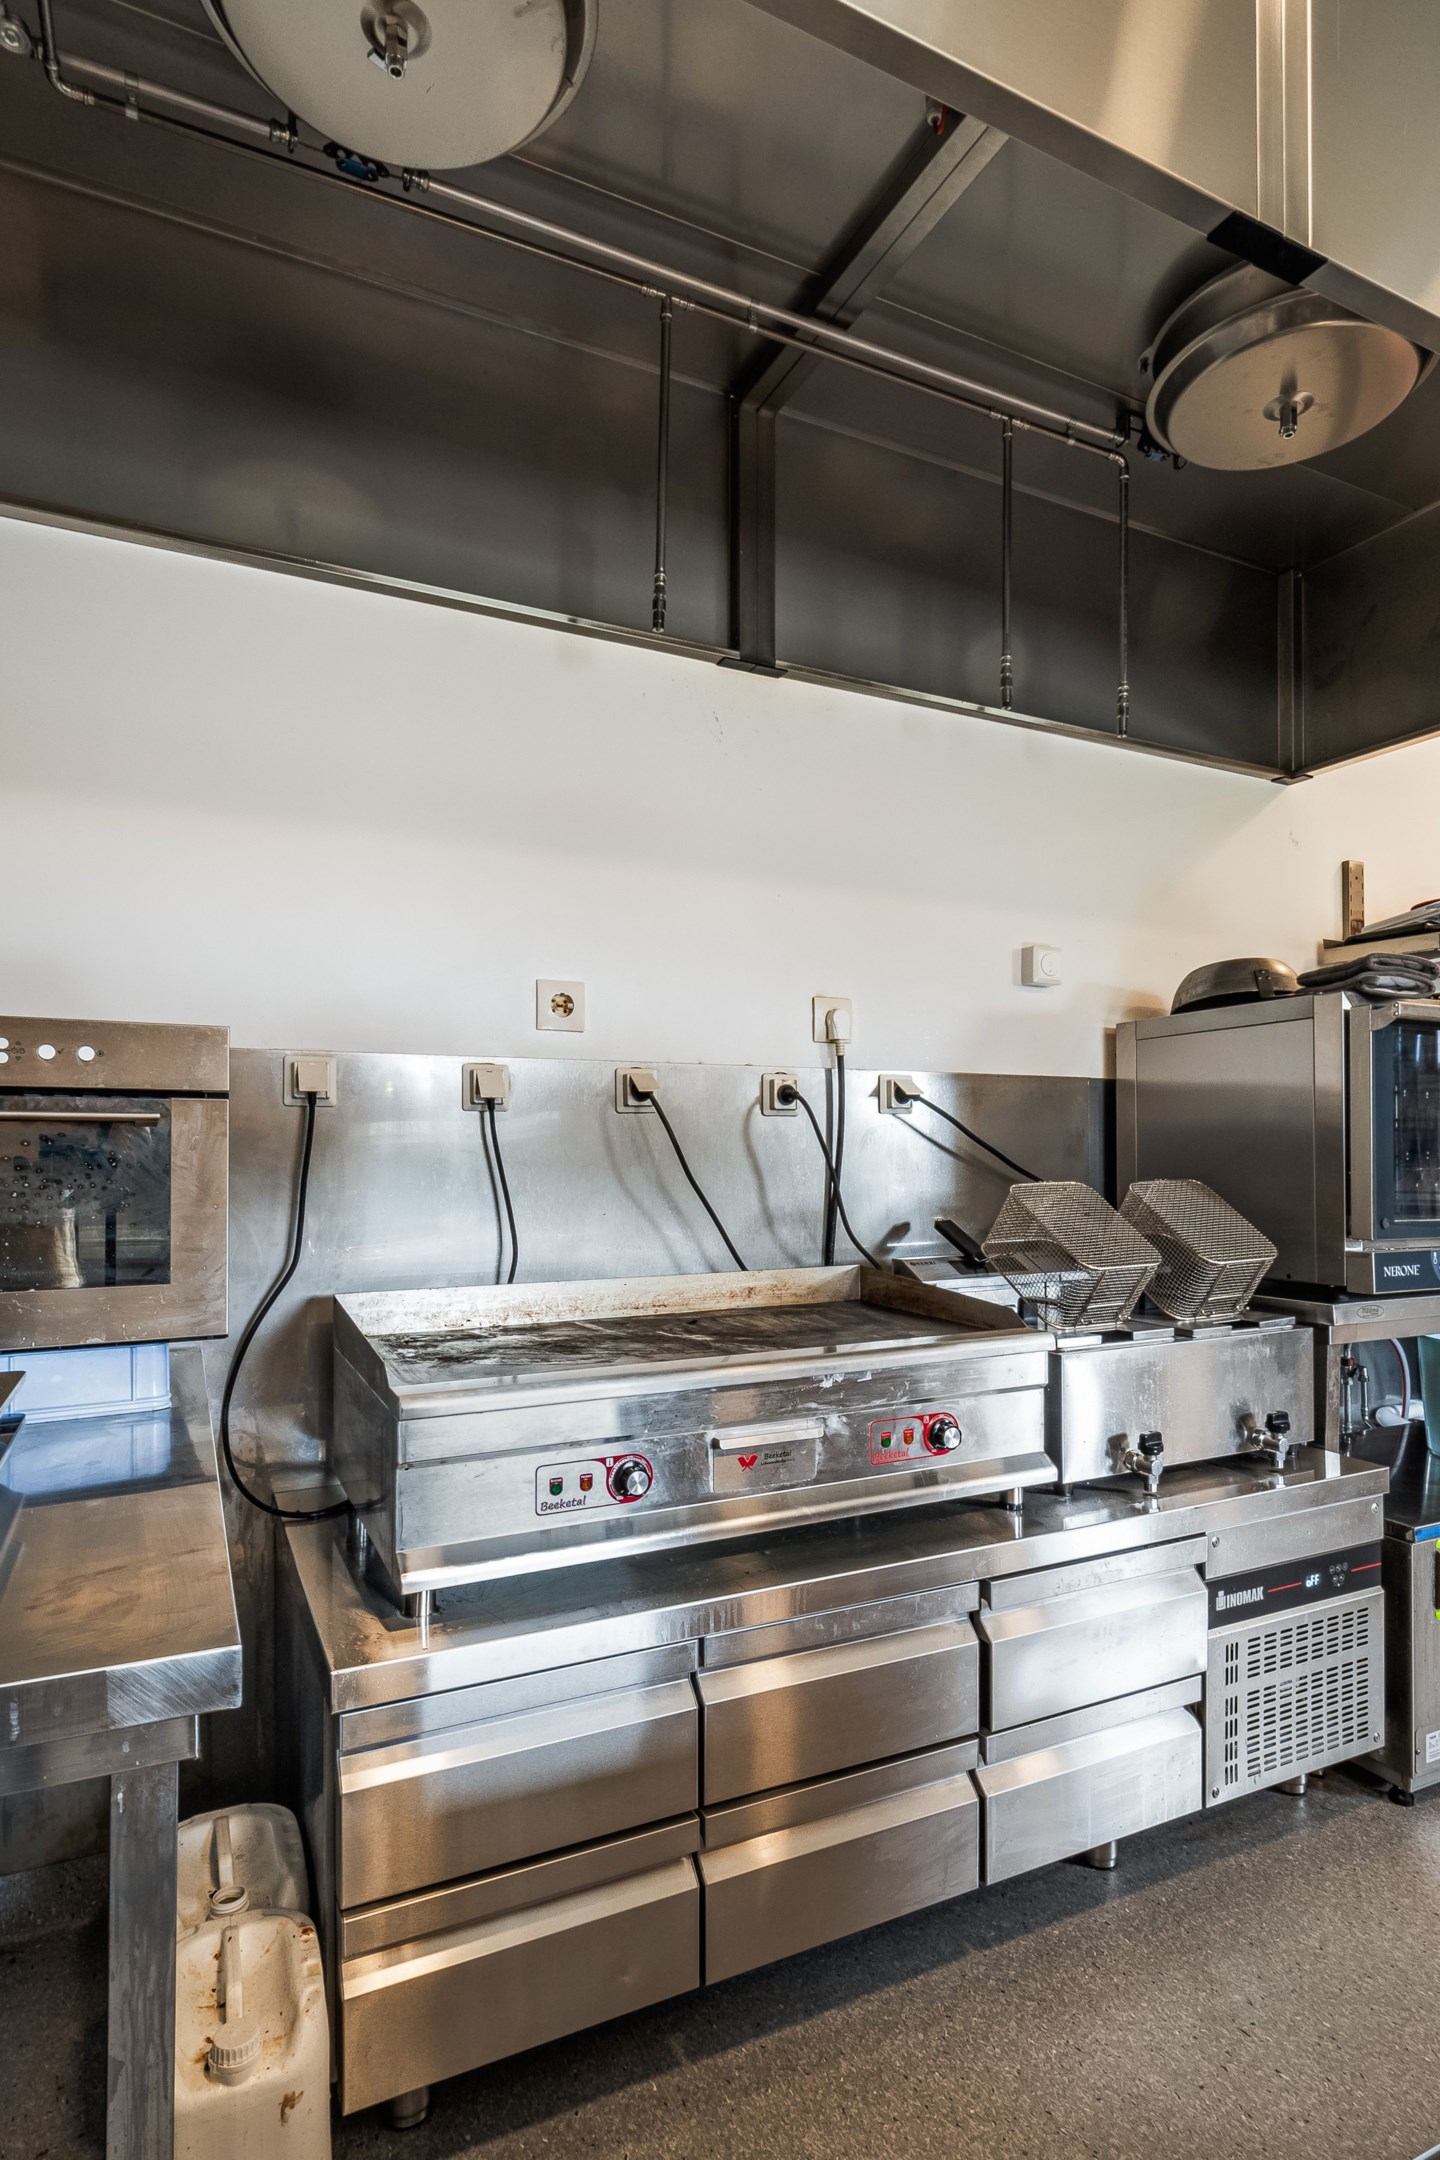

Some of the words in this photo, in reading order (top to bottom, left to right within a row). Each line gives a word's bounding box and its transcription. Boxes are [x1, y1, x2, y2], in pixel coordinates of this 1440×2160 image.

[1384, 1264, 1420, 1277] NERONE
[764, 1449, 792, 1460] Beeketal
[873, 1447, 909, 1461] Beeketal
[540, 1495, 587, 1511] Beeketal
[1226, 1586, 1264, 1608] INOMAK
